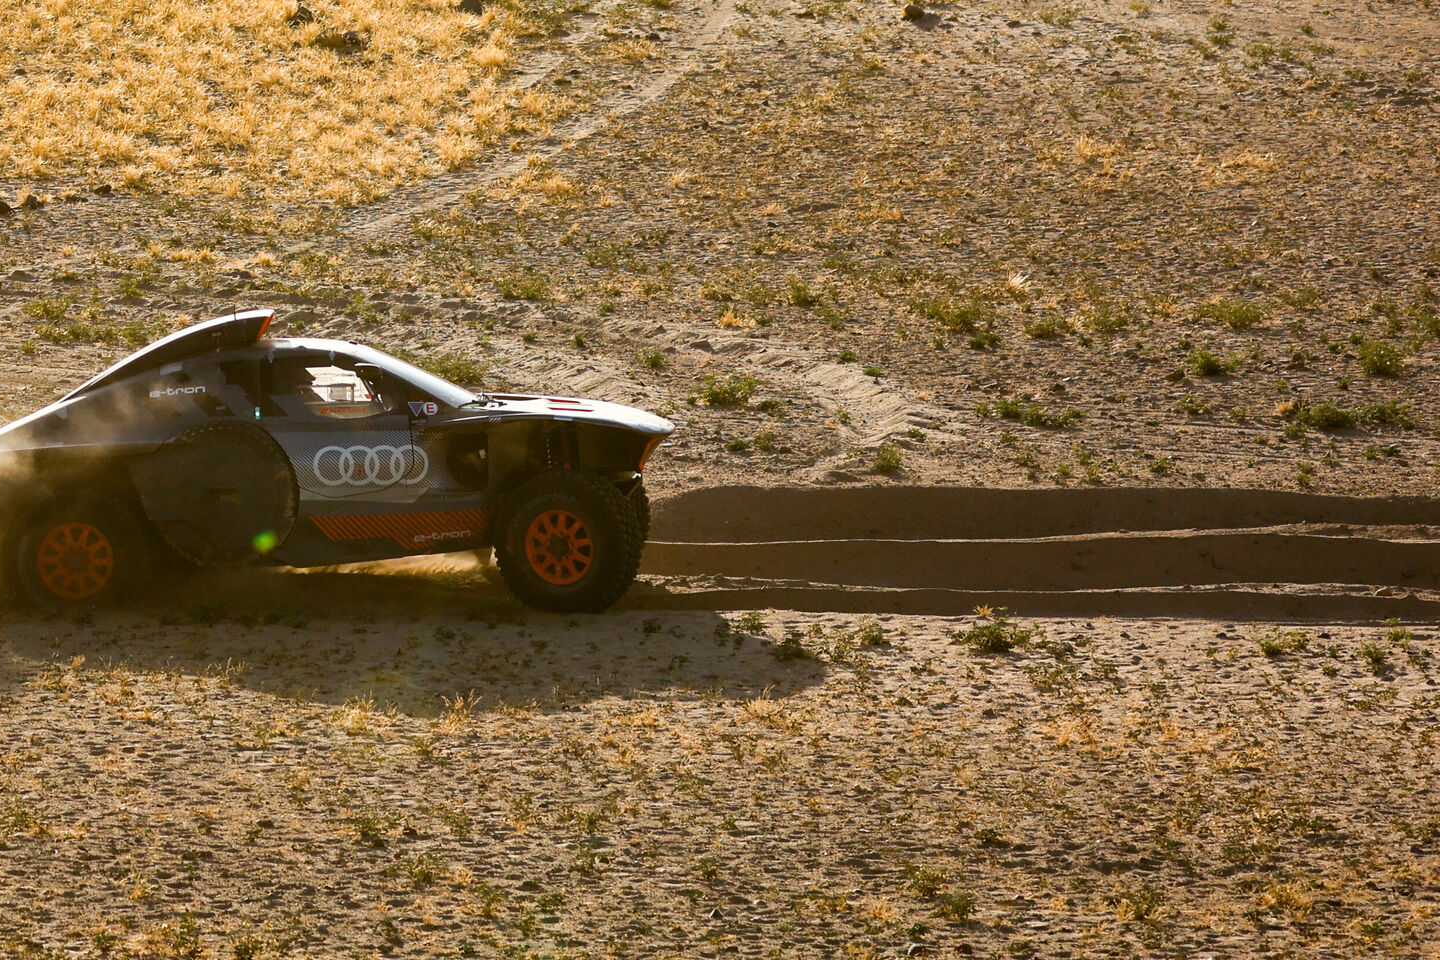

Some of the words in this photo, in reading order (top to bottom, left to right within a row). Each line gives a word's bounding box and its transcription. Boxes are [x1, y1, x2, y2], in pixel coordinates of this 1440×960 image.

[149, 386, 206, 398] e-tron
[426, 403, 435, 414] E
[414, 529, 471, 542] e-tron
